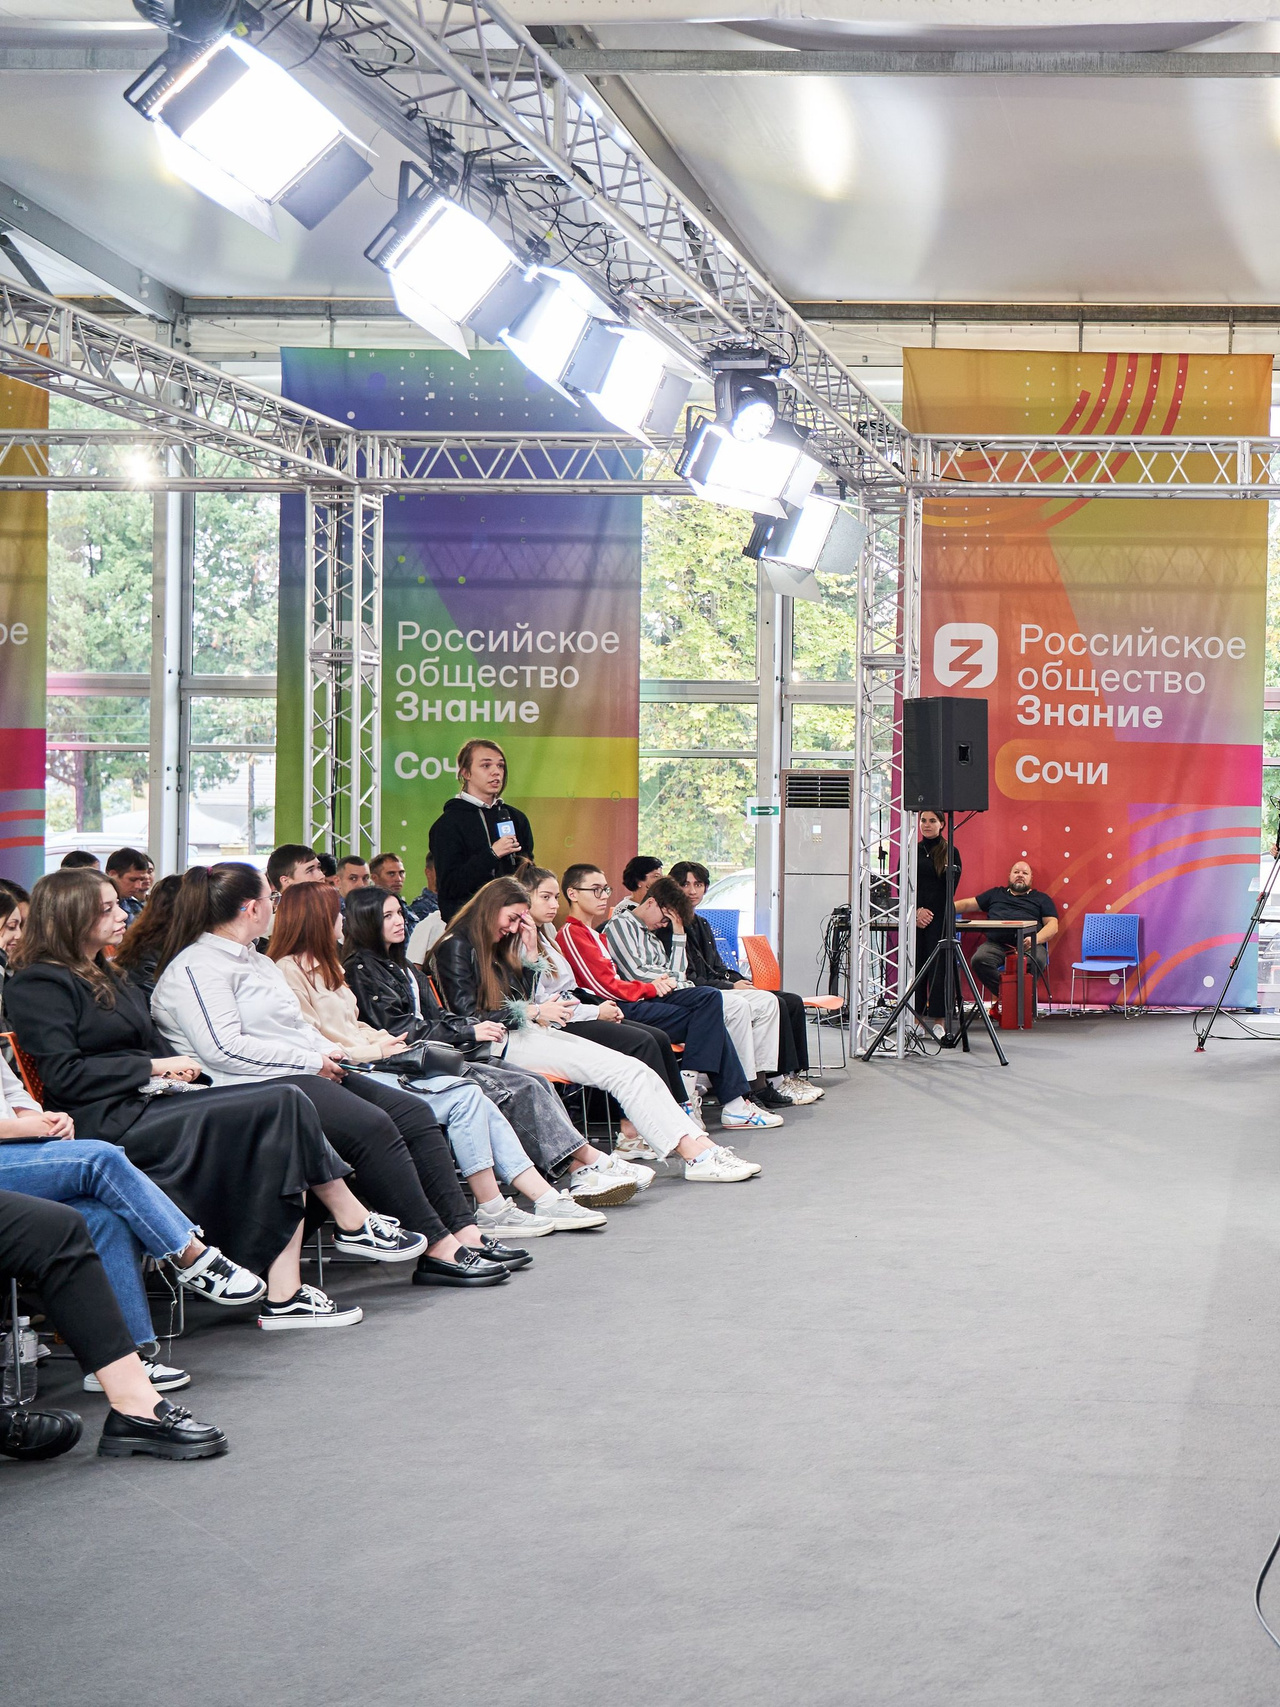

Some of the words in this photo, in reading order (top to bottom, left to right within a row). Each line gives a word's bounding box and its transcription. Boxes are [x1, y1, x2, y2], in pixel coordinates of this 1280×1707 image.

[397, 621, 620, 654] Российское
[1020, 623, 1247, 660] Российское
[396, 656, 580, 692] общество
[1018, 660, 1206, 695] общество
[395, 691, 540, 724] Знание
[1017, 695, 1163, 729] Знание
[394, 751, 461, 781] Соч
[1015, 755, 1109, 786] Сочи
